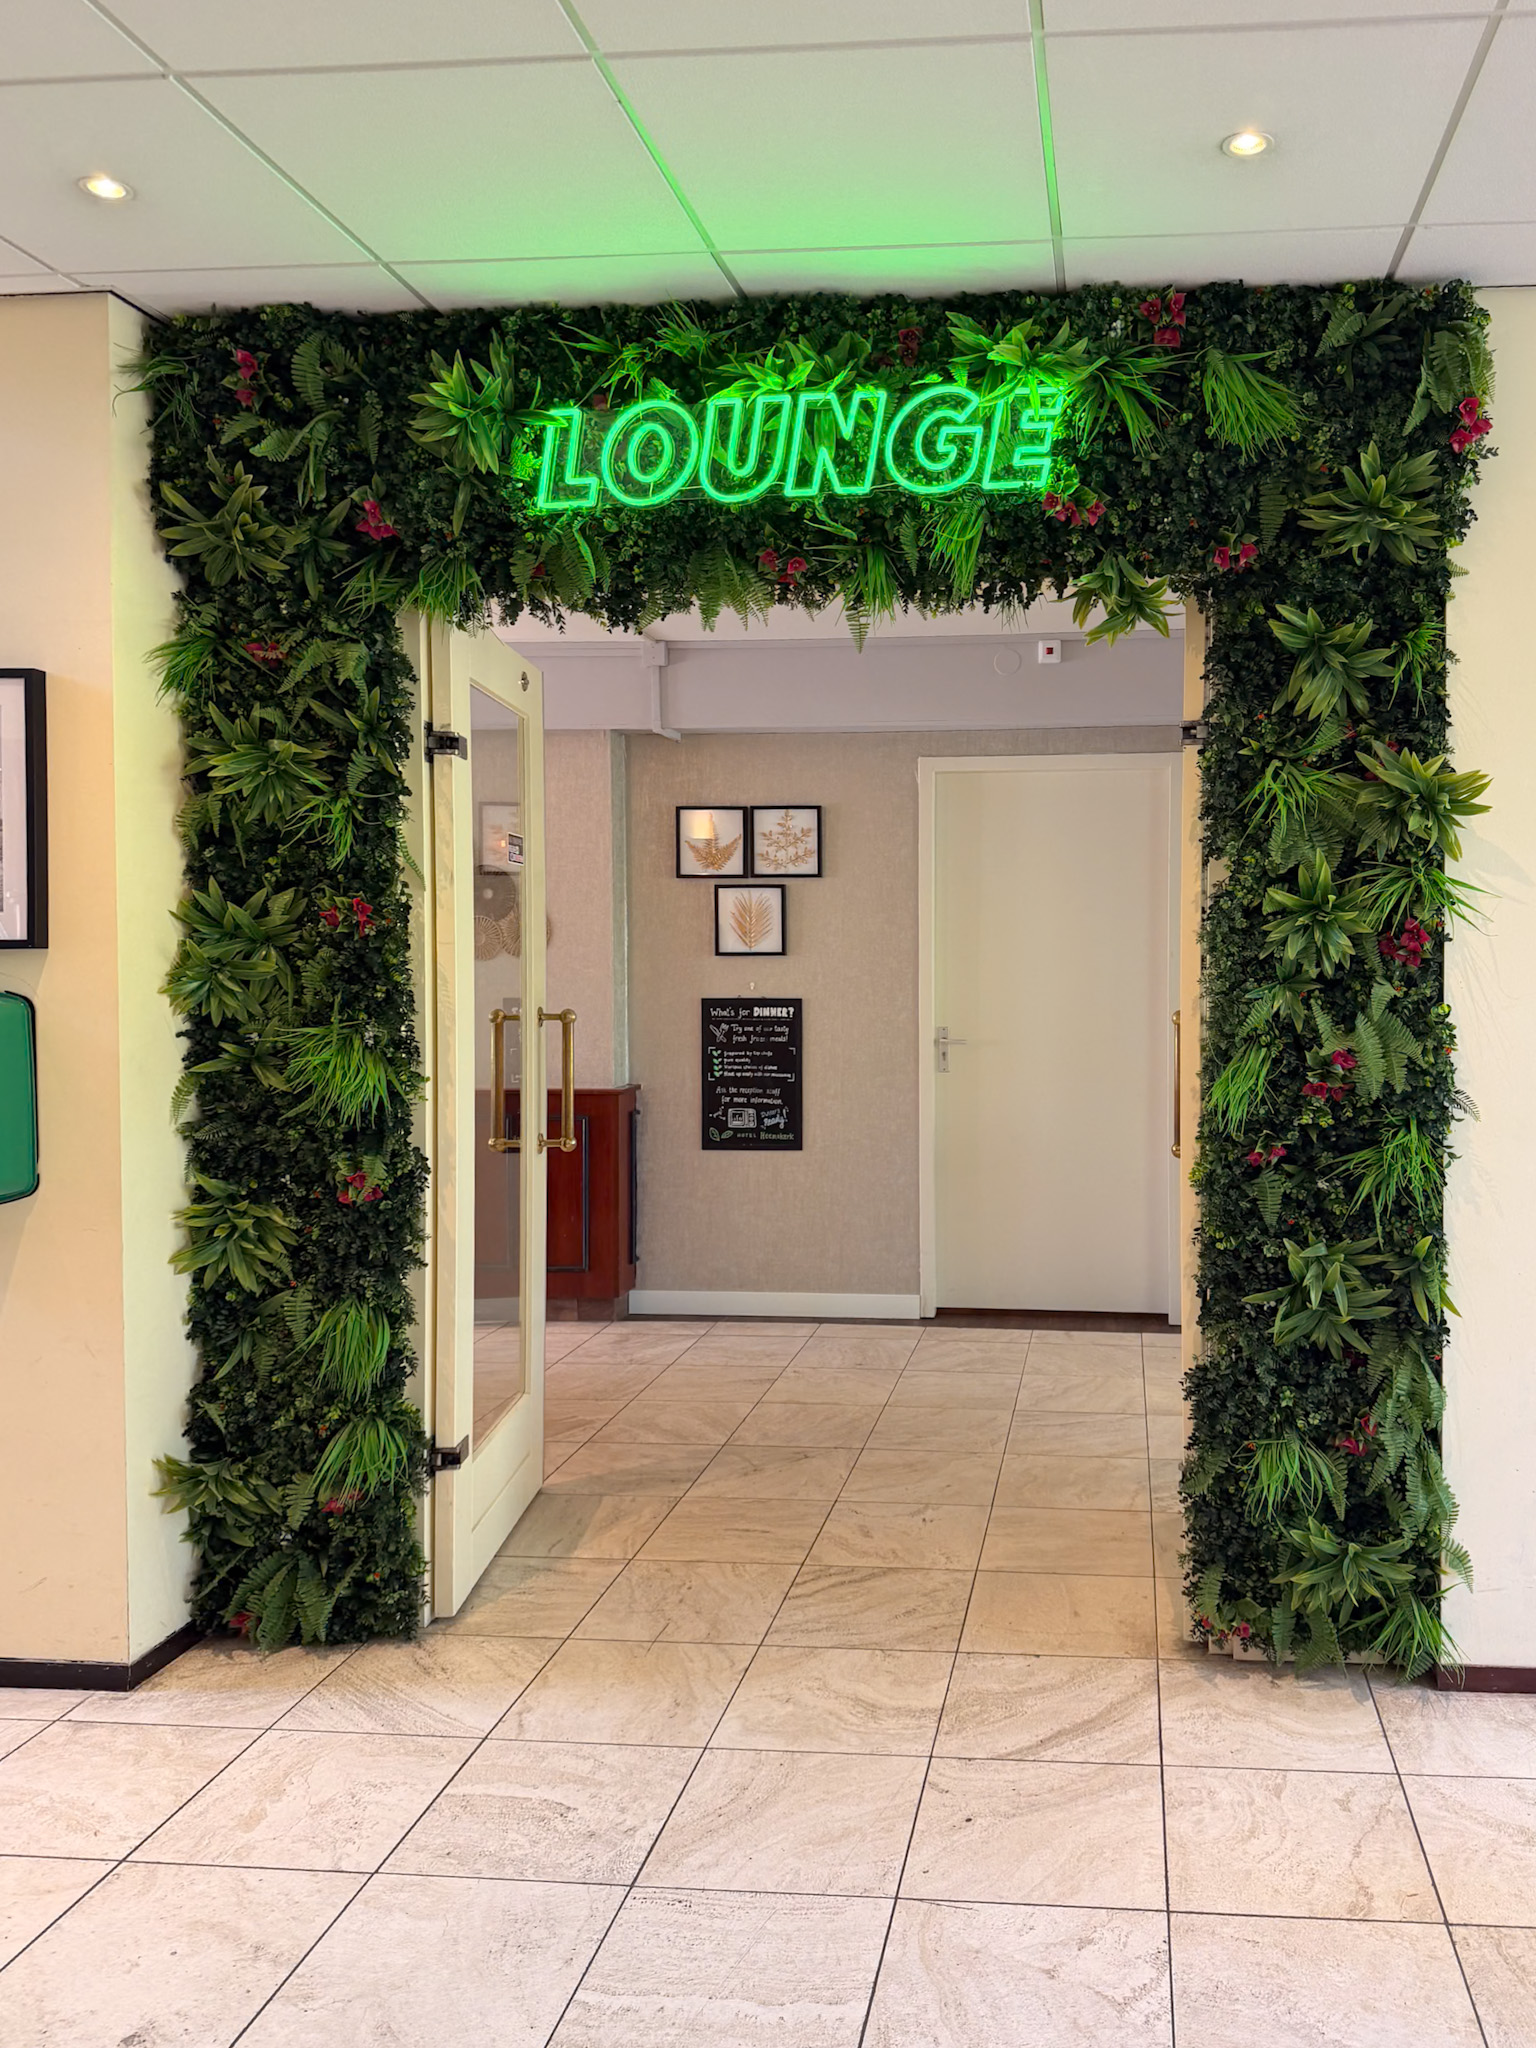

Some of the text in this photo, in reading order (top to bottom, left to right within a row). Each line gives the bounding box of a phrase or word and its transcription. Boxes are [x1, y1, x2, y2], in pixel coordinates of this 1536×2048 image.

[537, 383, 1064, 510] LOUNGE
[710, 1007, 794, 1019] What's for DINNER?
[731, 1024, 742, 1033] Try
[756, 1025, 762, 1033] of
[774, 1025, 789, 1034] tasty
[733, 1035, 747, 1044] fresh
[740, 1087, 763, 1095] reception
[722, 1096, 730, 1104] for
